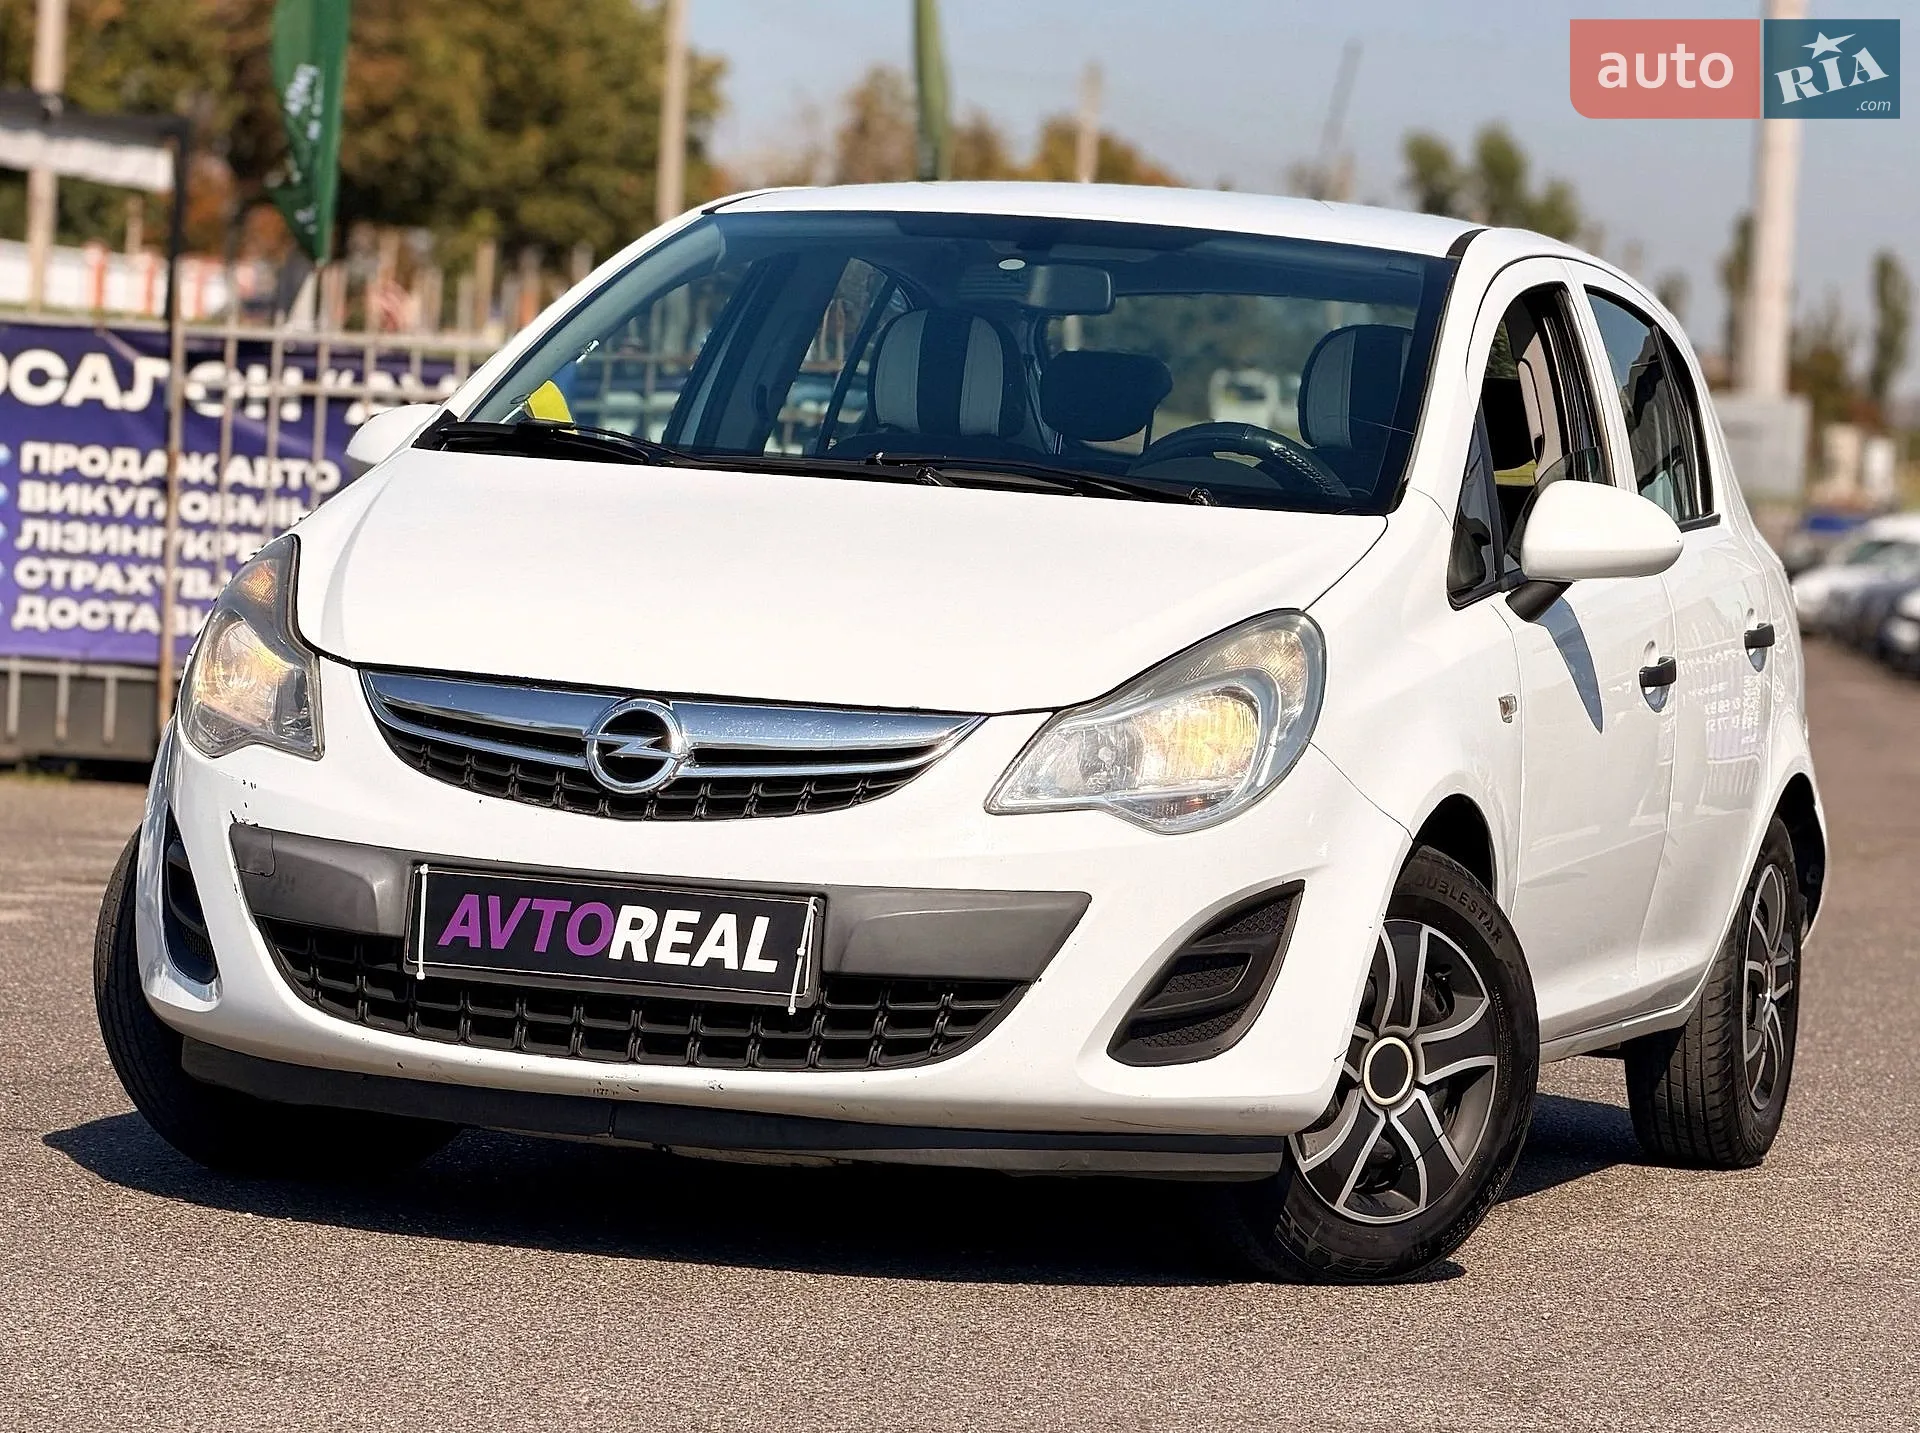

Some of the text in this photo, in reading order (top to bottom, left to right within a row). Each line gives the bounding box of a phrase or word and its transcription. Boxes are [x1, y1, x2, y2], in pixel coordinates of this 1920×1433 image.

[0, 348, 304, 424] САЛОН
[19, 440, 219, 486] ПРОДАЖ
[437, 892, 780, 974] AVTOREAL
[1402, 874, 1504, 945] OUBLESTAR
